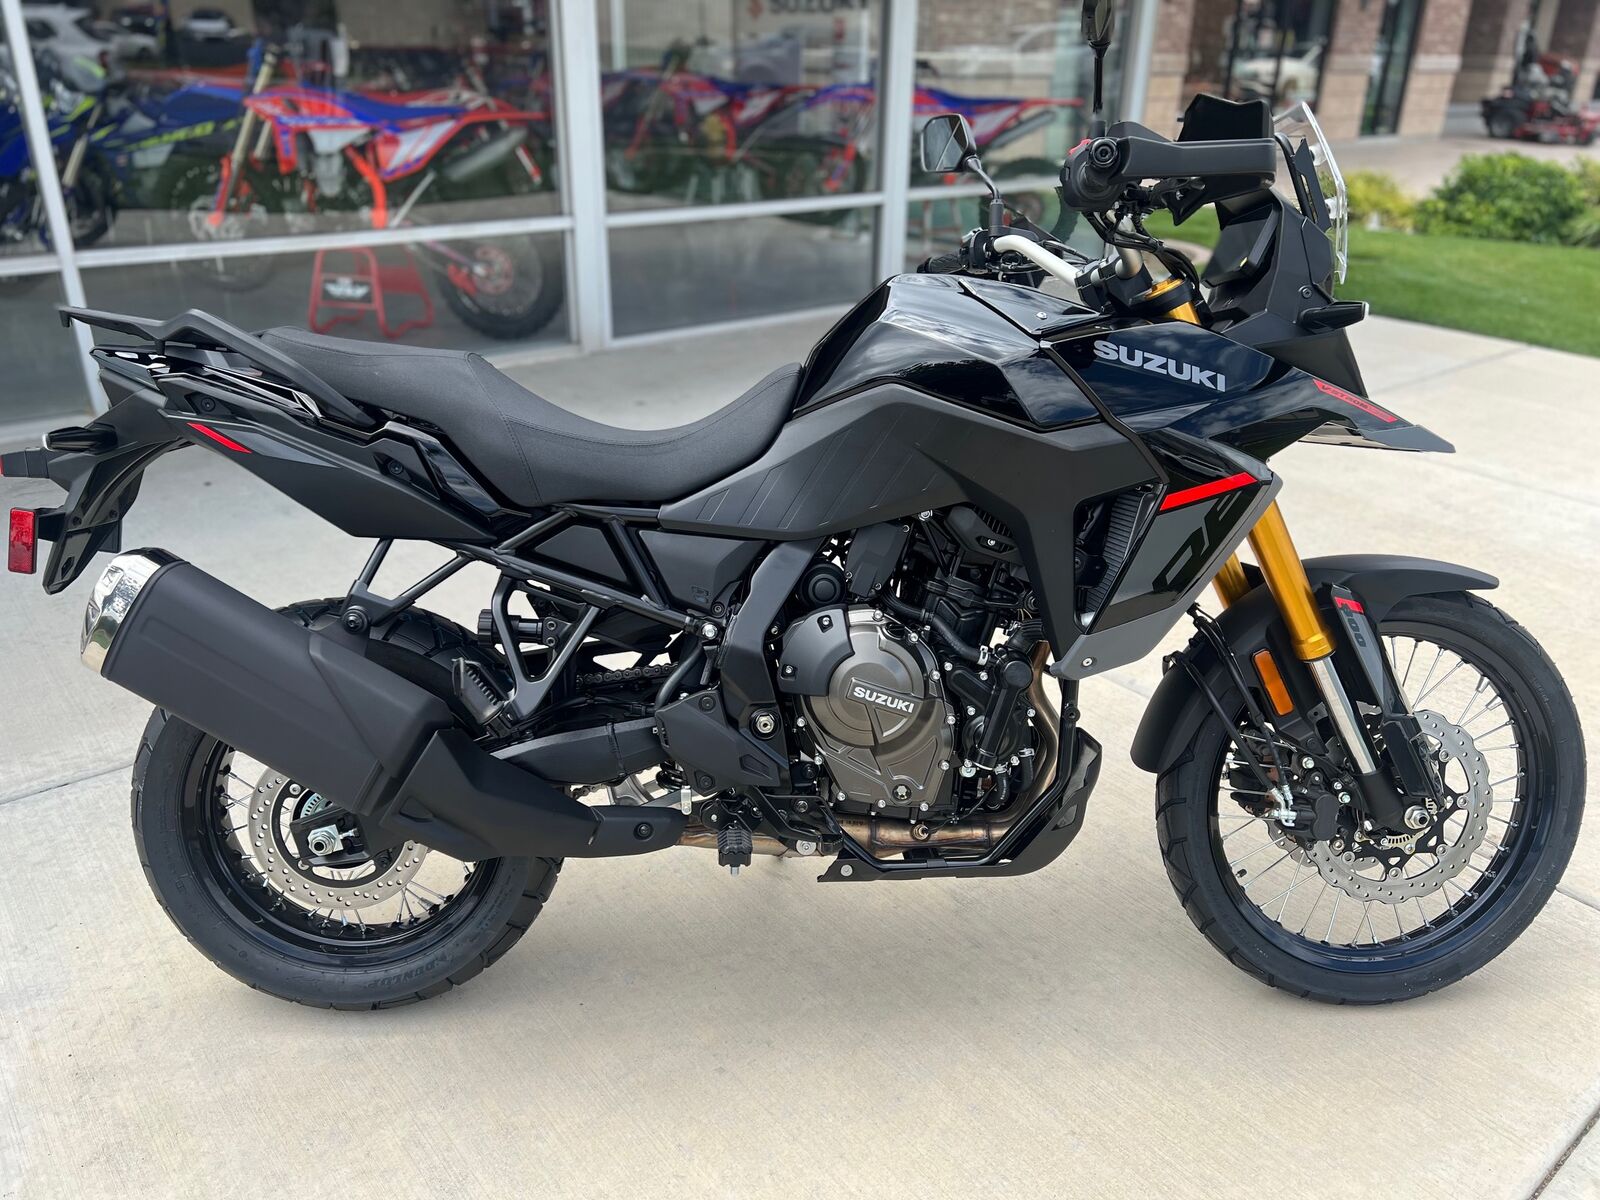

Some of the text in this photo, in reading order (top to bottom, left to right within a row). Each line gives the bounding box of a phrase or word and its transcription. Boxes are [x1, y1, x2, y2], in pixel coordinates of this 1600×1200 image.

[1093, 340, 1226, 392] SUZUKI
[1340, 603, 1367, 648] 800
[853, 686, 915, 713] SUZUKI
